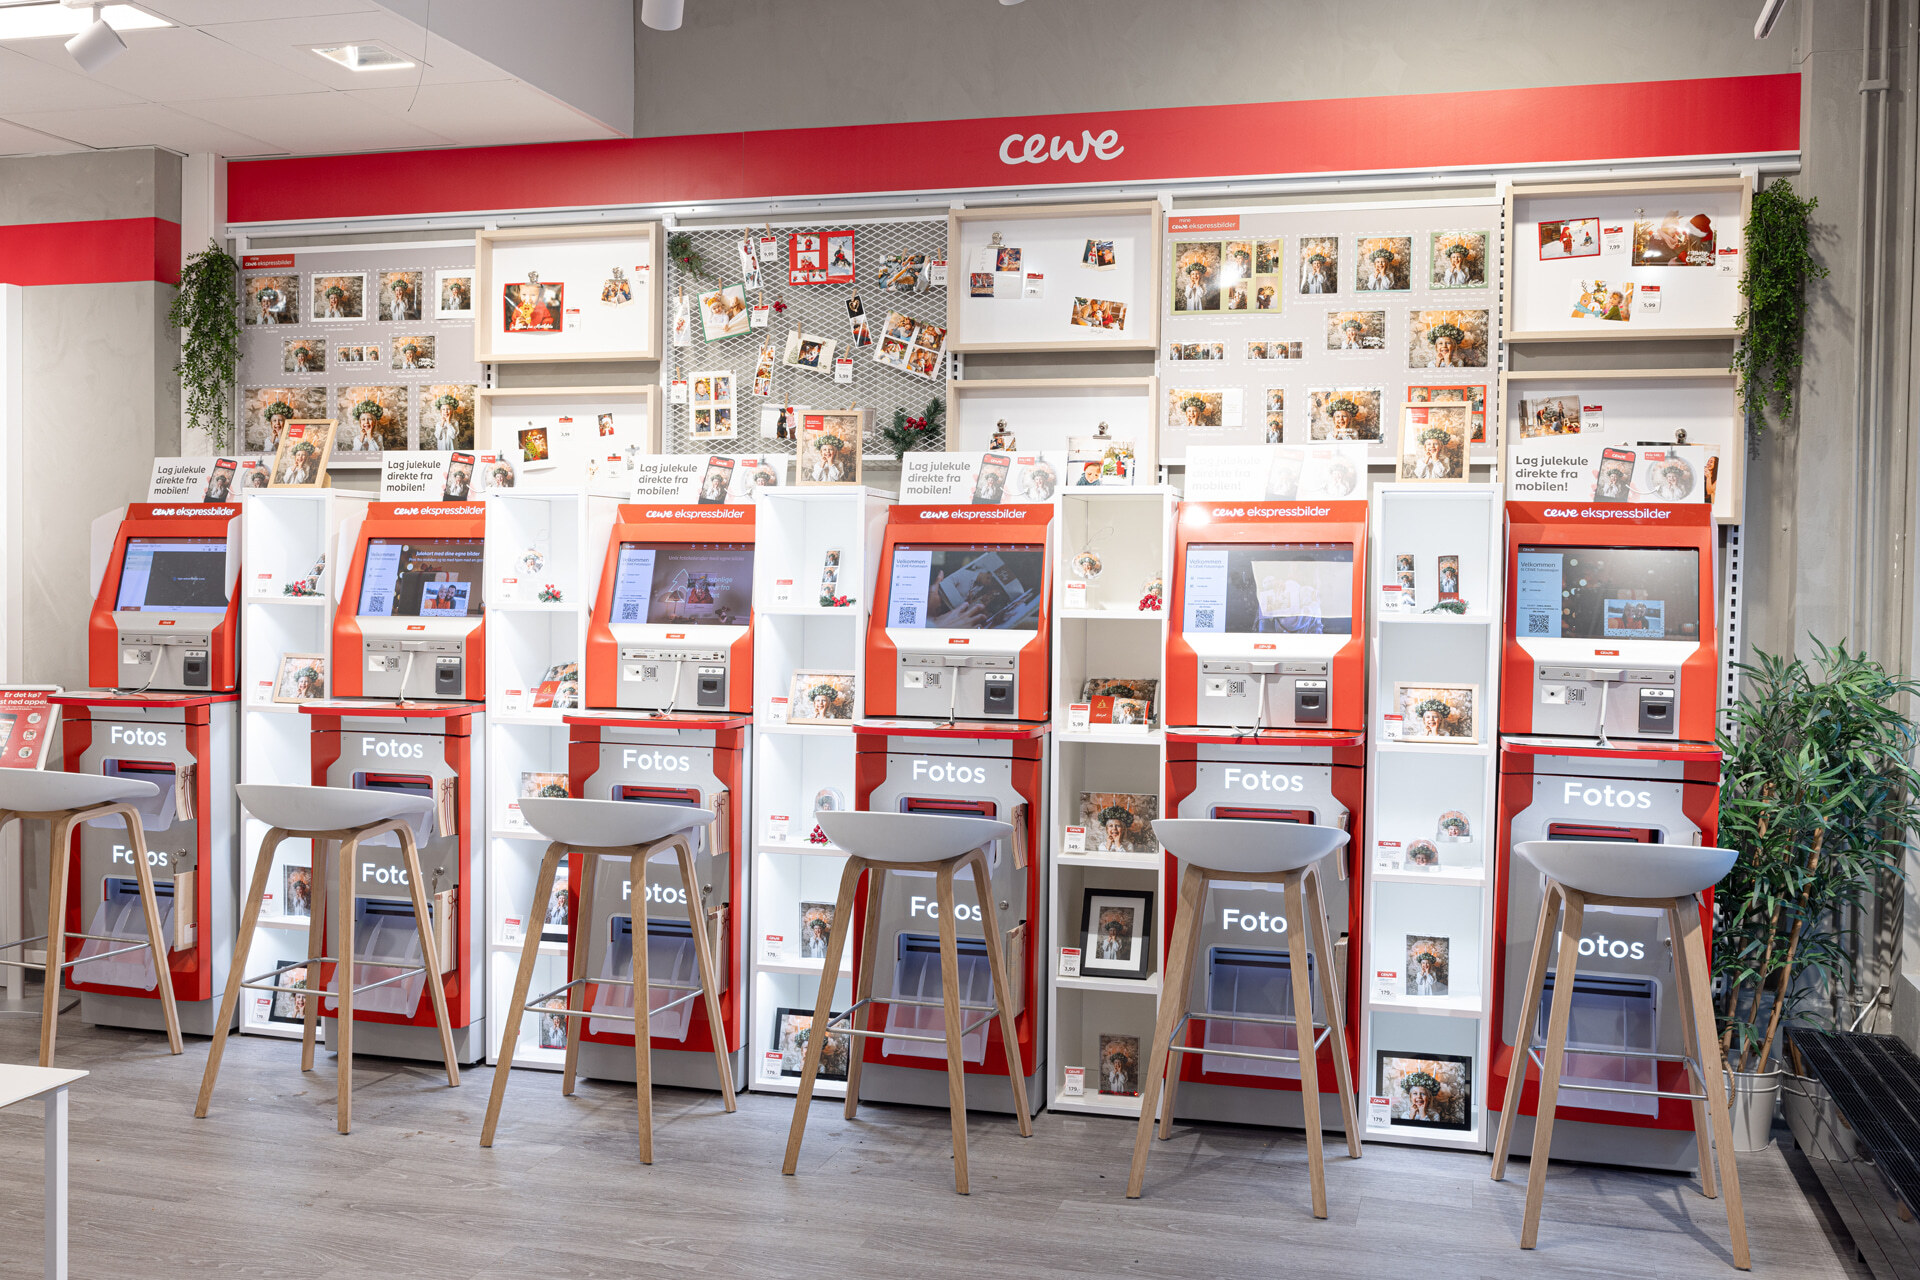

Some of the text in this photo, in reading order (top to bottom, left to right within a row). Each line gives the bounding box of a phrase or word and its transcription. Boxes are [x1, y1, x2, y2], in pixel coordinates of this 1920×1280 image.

[999, 129, 1125, 165] cewe
[1189, 222, 1236, 230] ekspressbilder
[388, 460, 441, 471] Lag julekule
[909, 461, 971, 473] Lag julekule
[1515, 455, 1589, 467] Lag julekule
[158, 465, 206, 476] Lag julekule
[640, 463, 698, 476] Lag julekule
[1515, 468, 1578, 479] direkte fra
[156, 475, 198, 485] direkte fra
[387, 471, 433, 481] direkte fra
[638, 475, 689, 485] direkte fra
[907, 473, 961, 483] direkte fra
[154, 486, 190, 495] mobilen!
[386, 483, 426, 492] mobilen!
[637, 486, 679, 496] mobilen!
[906, 485, 952, 495] mobilen!
[1515, 481, 1568, 492] mobilen!
[176, 506, 235, 517] ekspressbilder
[420, 505, 485, 516] ekspressbilder
[674, 509, 745, 520] ekspressbilder
[951, 509, 1027, 521] ekspressbilder
[1247, 506, 1330, 519] ekspressbilder
[1581, 508, 1671, 521] ekspressbilder
[111, 726, 167, 747] Fotos
[362, 737, 424, 759] Fotos
[623, 749, 690, 772] Fotos
[912, 760, 986, 784] Fotos
[1224, 768, 1304, 792] Fotos
[1564, 782, 1652, 809] Fotos
[113, 845, 168, 867] Foos
[362, 862, 410, 885] Foto
[622, 881, 688, 904] Ftos
[911, 896, 983, 922] Foos
[1223, 908, 1288, 933] Foto
[1558, 931, 1645, 960] otos
